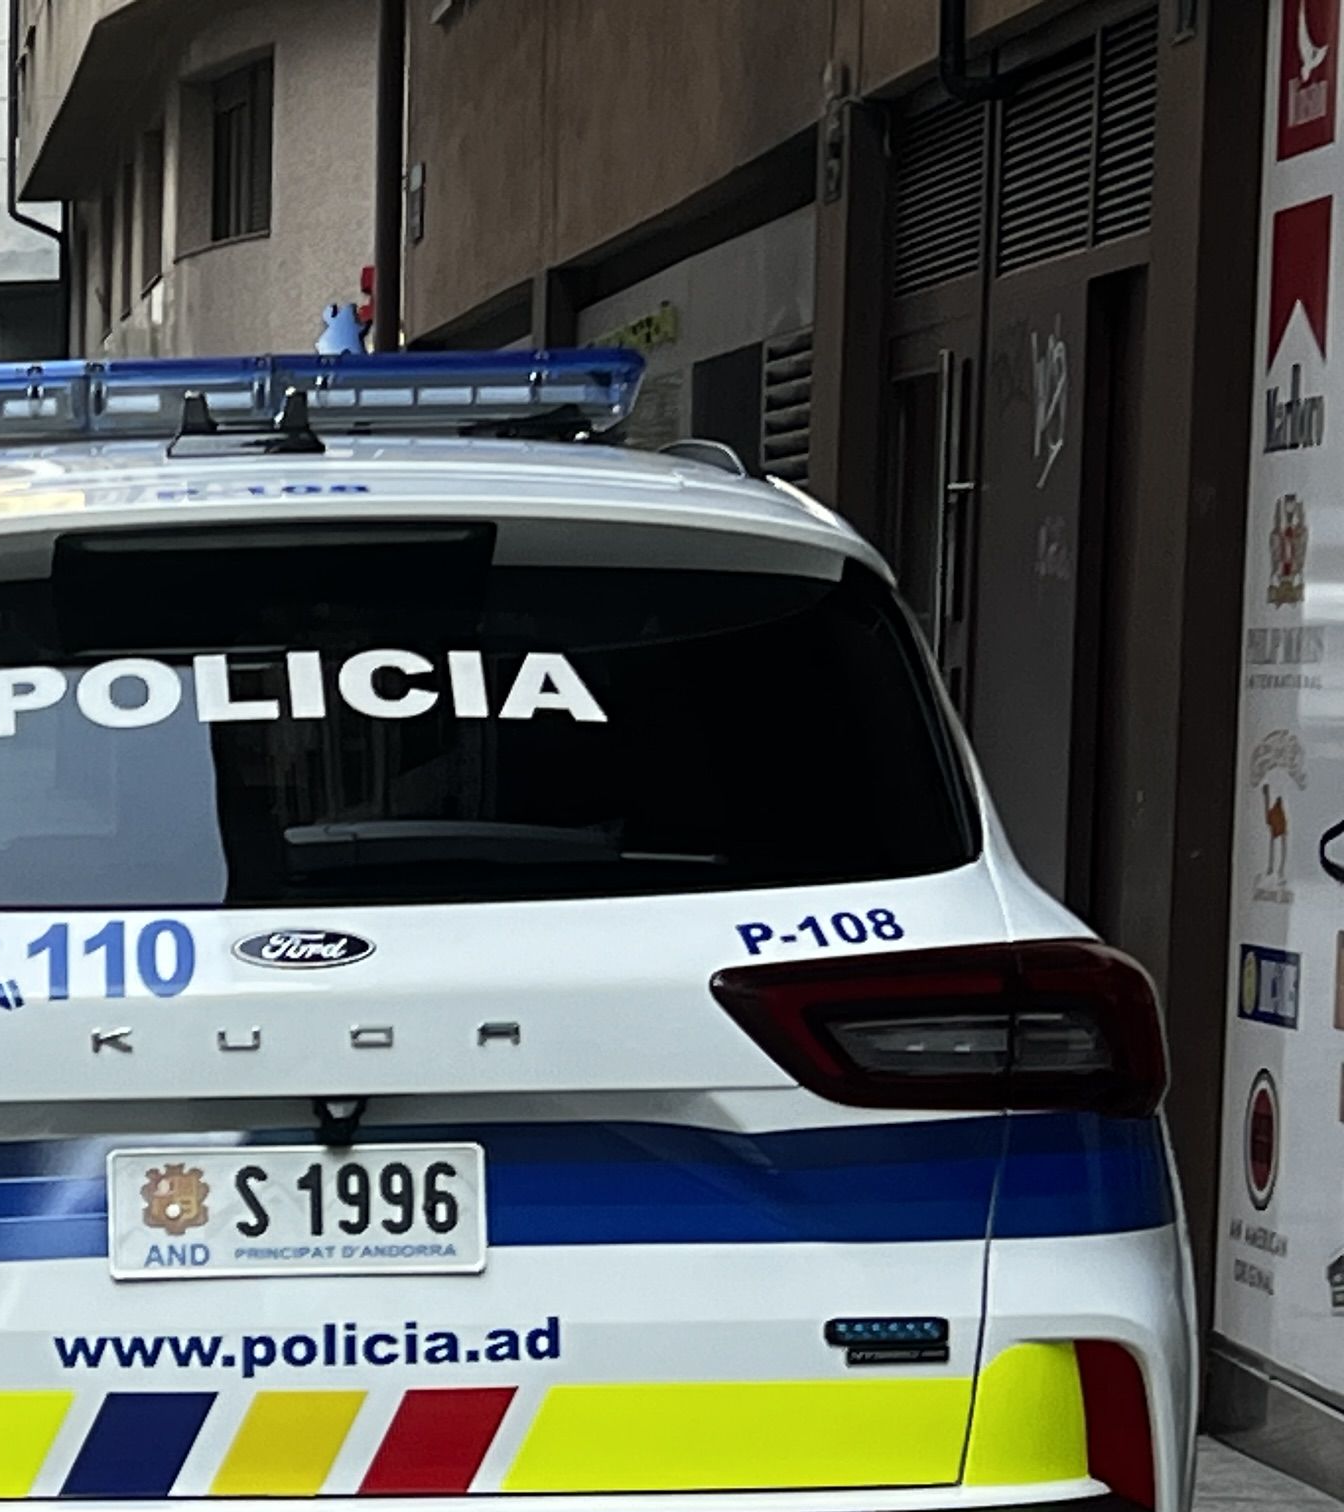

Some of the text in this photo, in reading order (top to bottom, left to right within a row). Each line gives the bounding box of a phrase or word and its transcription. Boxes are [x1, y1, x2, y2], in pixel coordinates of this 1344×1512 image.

[27, 908, 904, 1001] 110 Ford P-108
[235, 1161, 458, 1237] S 1996
[144, 1243, 457, 1268] AND PRINCIPAT D'ANDORRA
[54, 1316, 561, 1379] www.policia.ad
